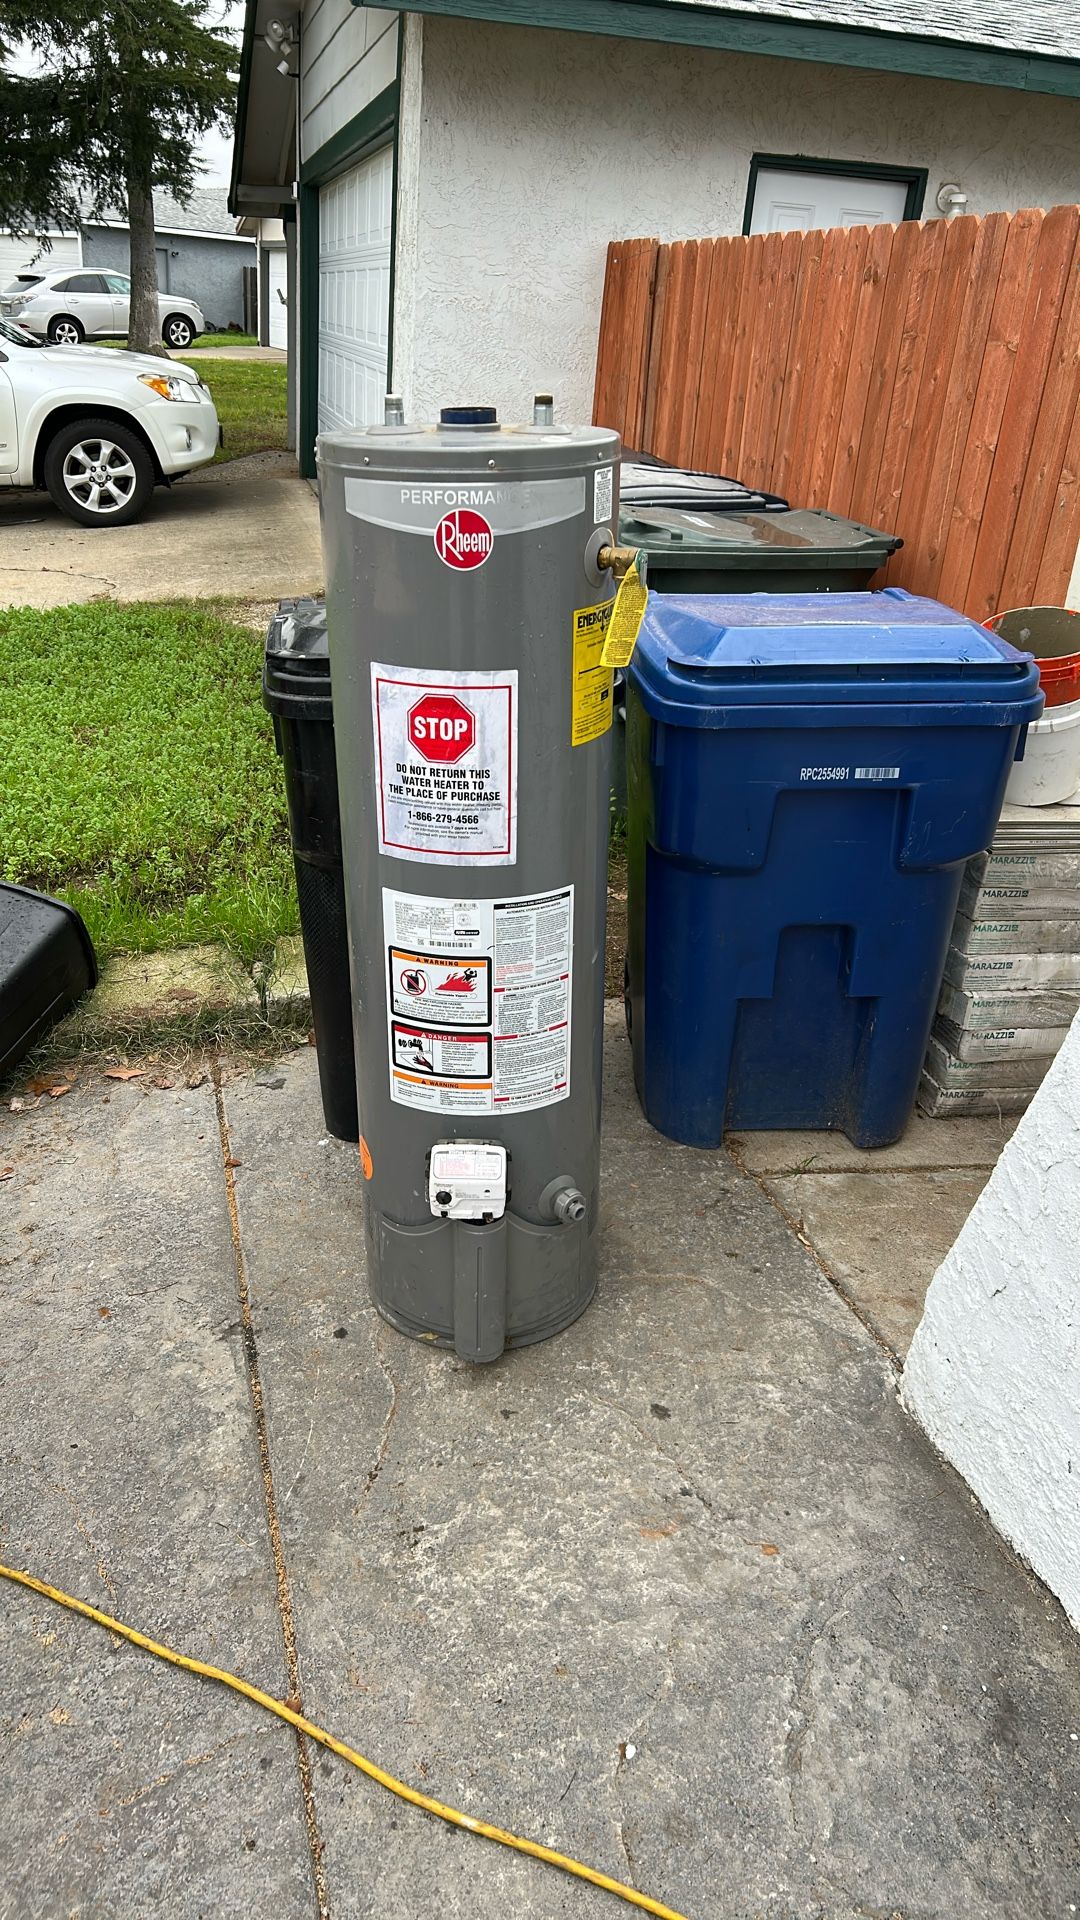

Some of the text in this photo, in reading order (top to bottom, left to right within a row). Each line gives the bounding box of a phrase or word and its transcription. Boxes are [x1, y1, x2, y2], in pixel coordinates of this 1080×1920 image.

[441, 510, 490, 561] Rheem
[413, 715, 469, 741] STOP
[396, 763, 491, 779] DO NOT RETURN THIS
[800, 767, 850, 781] RPC2554991
[402, 775, 484, 790] WATER HEATER TO
[389, 783, 404, 795] THE
[406, 787, 434, 799] PLACE
[436, 790, 448, 800] OF
[451, 791, 501, 802] PURCHASE
[408, 810, 479, 824] 1-866-279-4566
[989, 856, 1028, 864] MARAZZI
[424, 958, 459, 966] WARNING
[967, 962, 1006, 970] MARAZZI
[971, 1031, 1008, 1040] MARAZZI
[430, 1080, 459, 1088] WARNING
